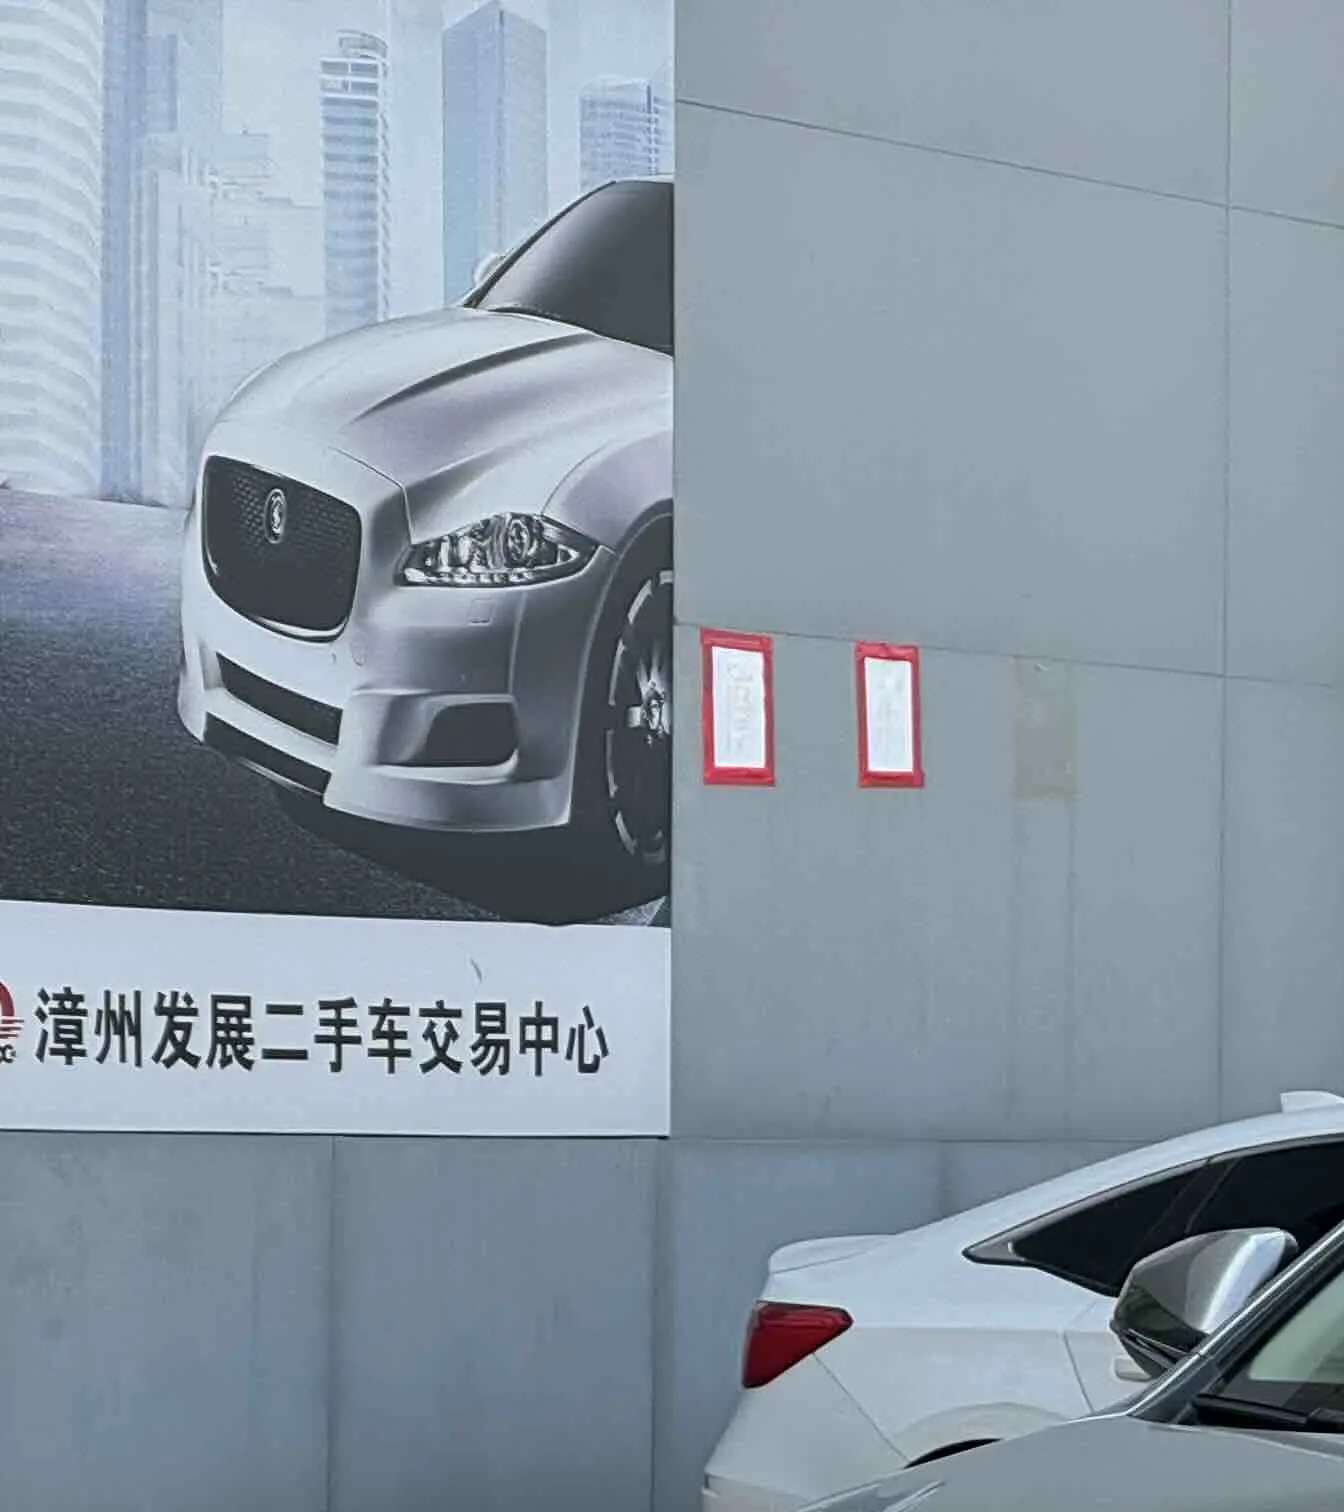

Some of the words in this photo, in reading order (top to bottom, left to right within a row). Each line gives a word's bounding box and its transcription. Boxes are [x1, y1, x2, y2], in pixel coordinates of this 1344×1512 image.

[34, 985, 609, 1077] 漳州发展二手车交易中心
